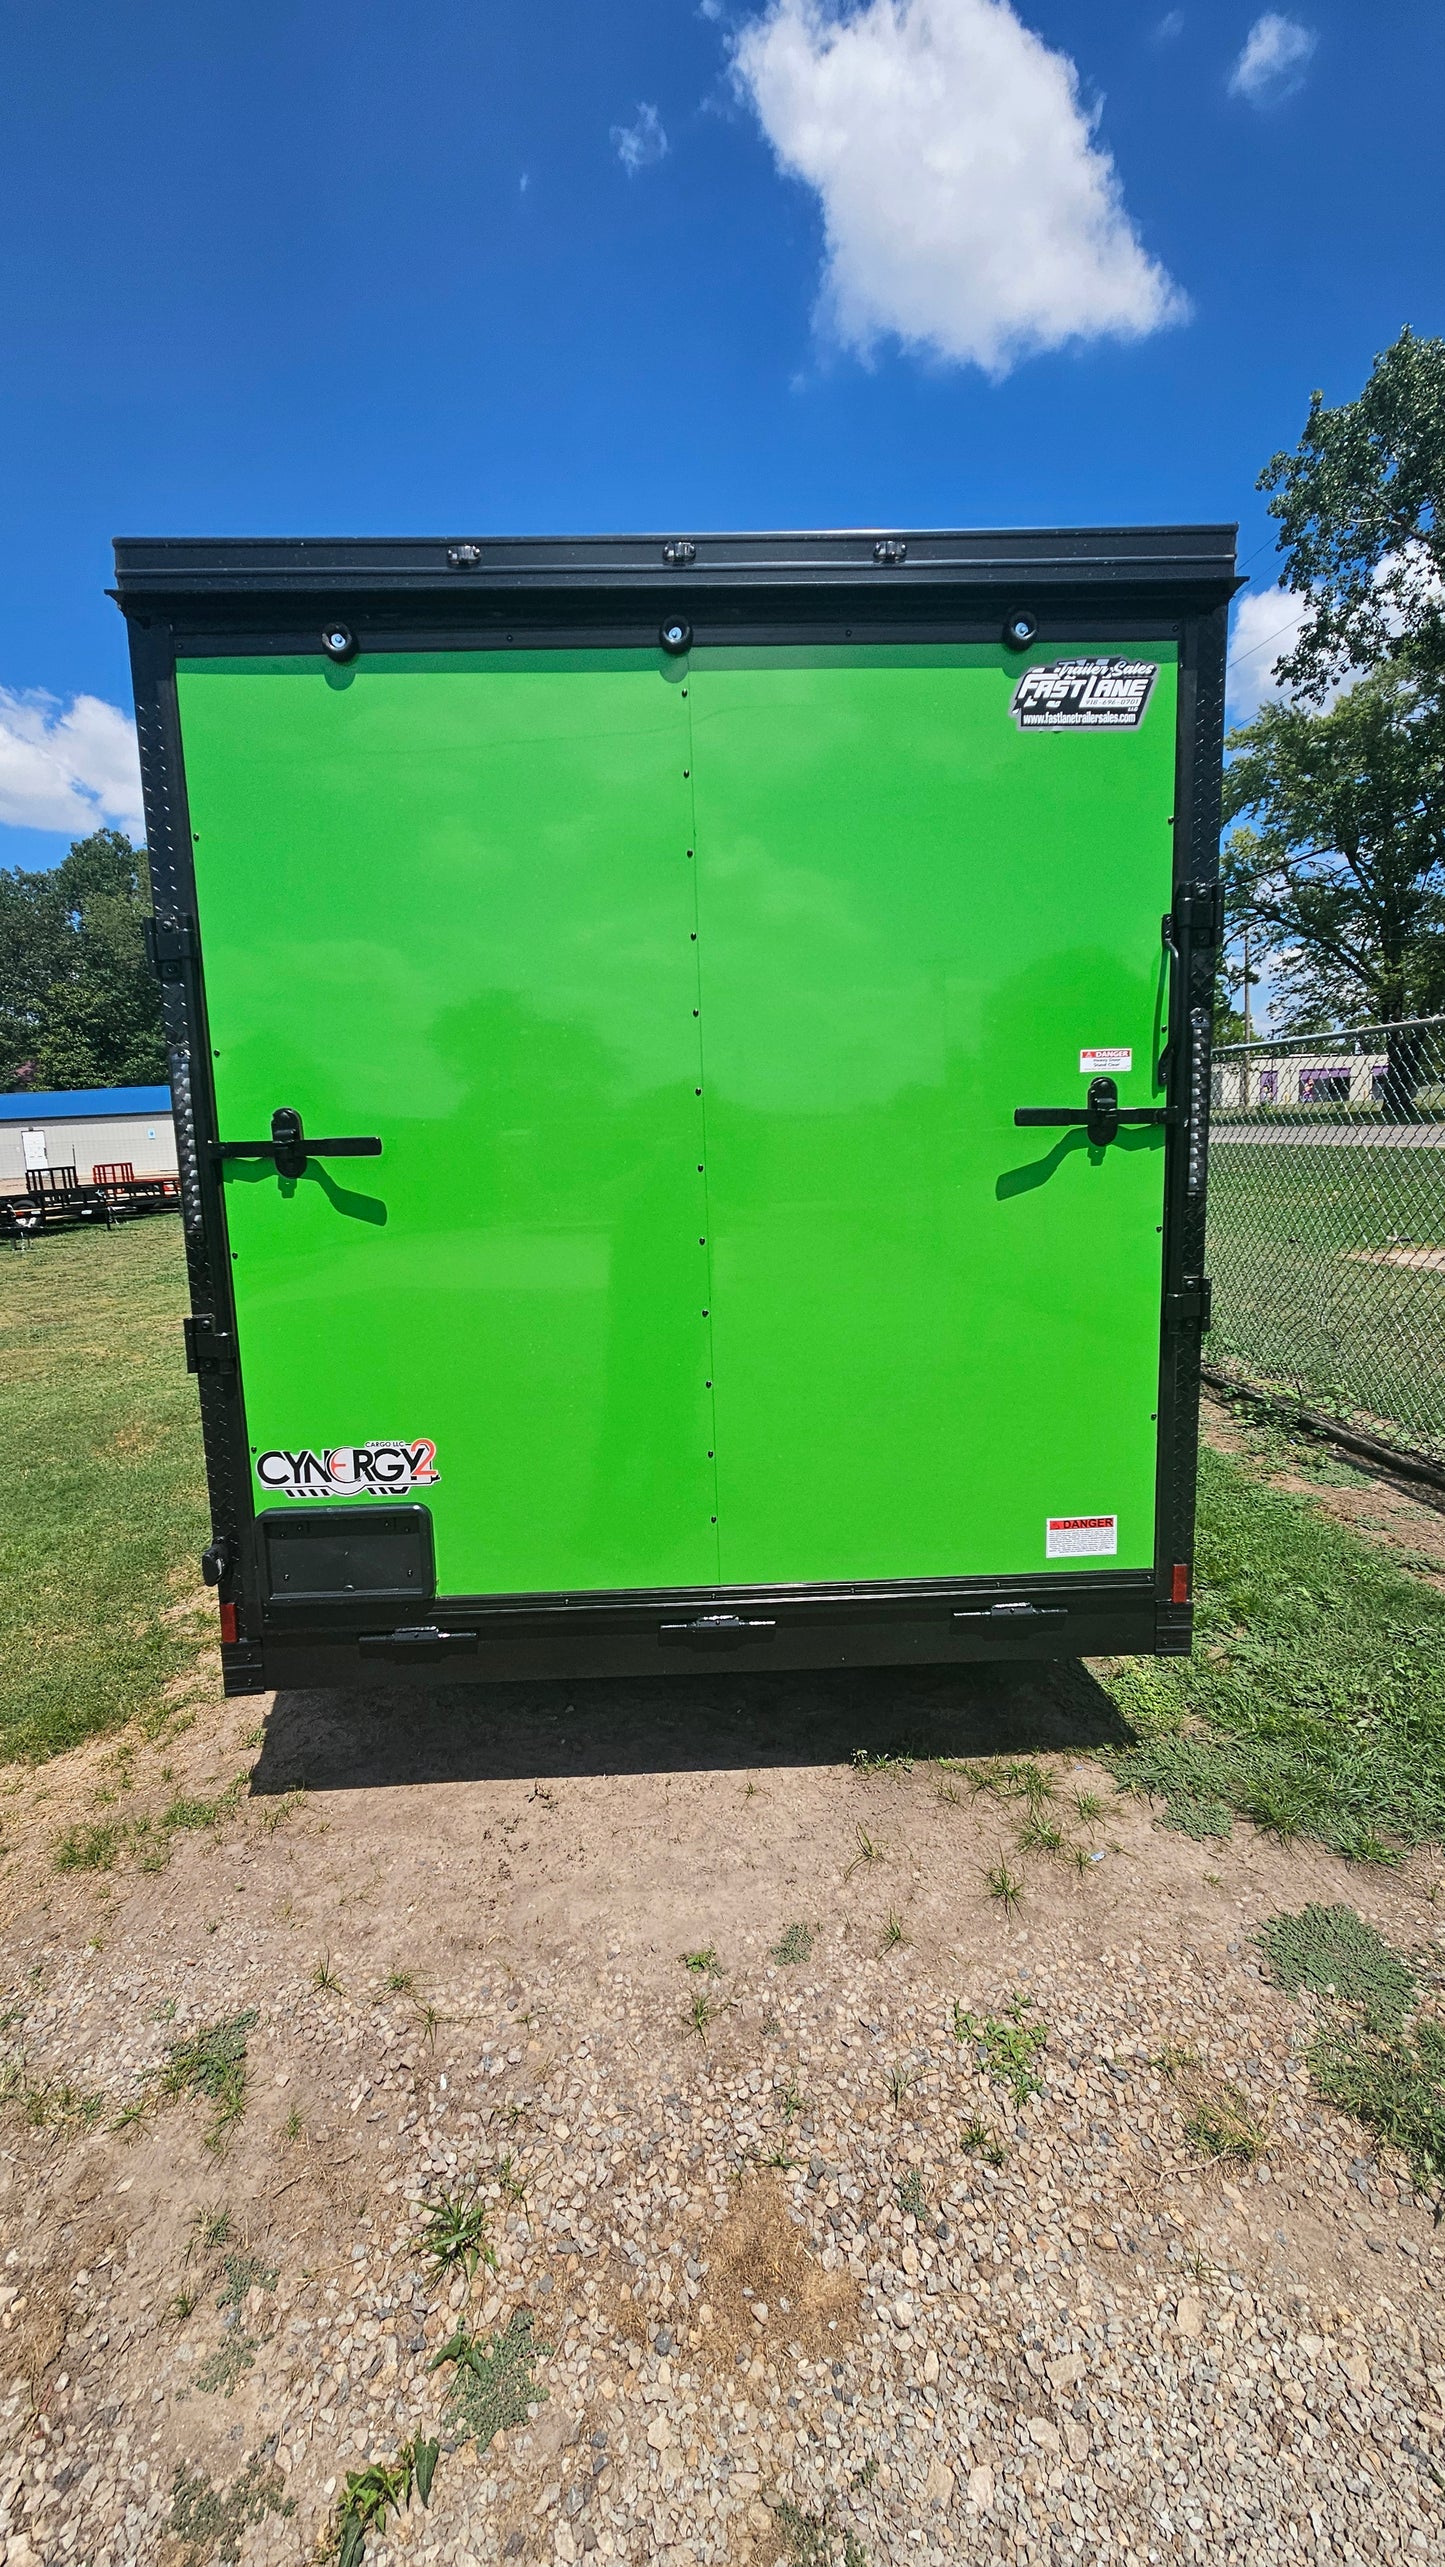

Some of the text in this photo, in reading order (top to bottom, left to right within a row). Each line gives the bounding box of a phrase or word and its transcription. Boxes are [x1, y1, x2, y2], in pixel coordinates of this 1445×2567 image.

[1058, 660, 1155, 676] Trailer Sales
[1023, 711, 1136, 725] www.fastlanetrailersales.com
[1095, 1050, 1129, 1058] DANGER
[1063, 1518, 1114, 1530] DANGER
